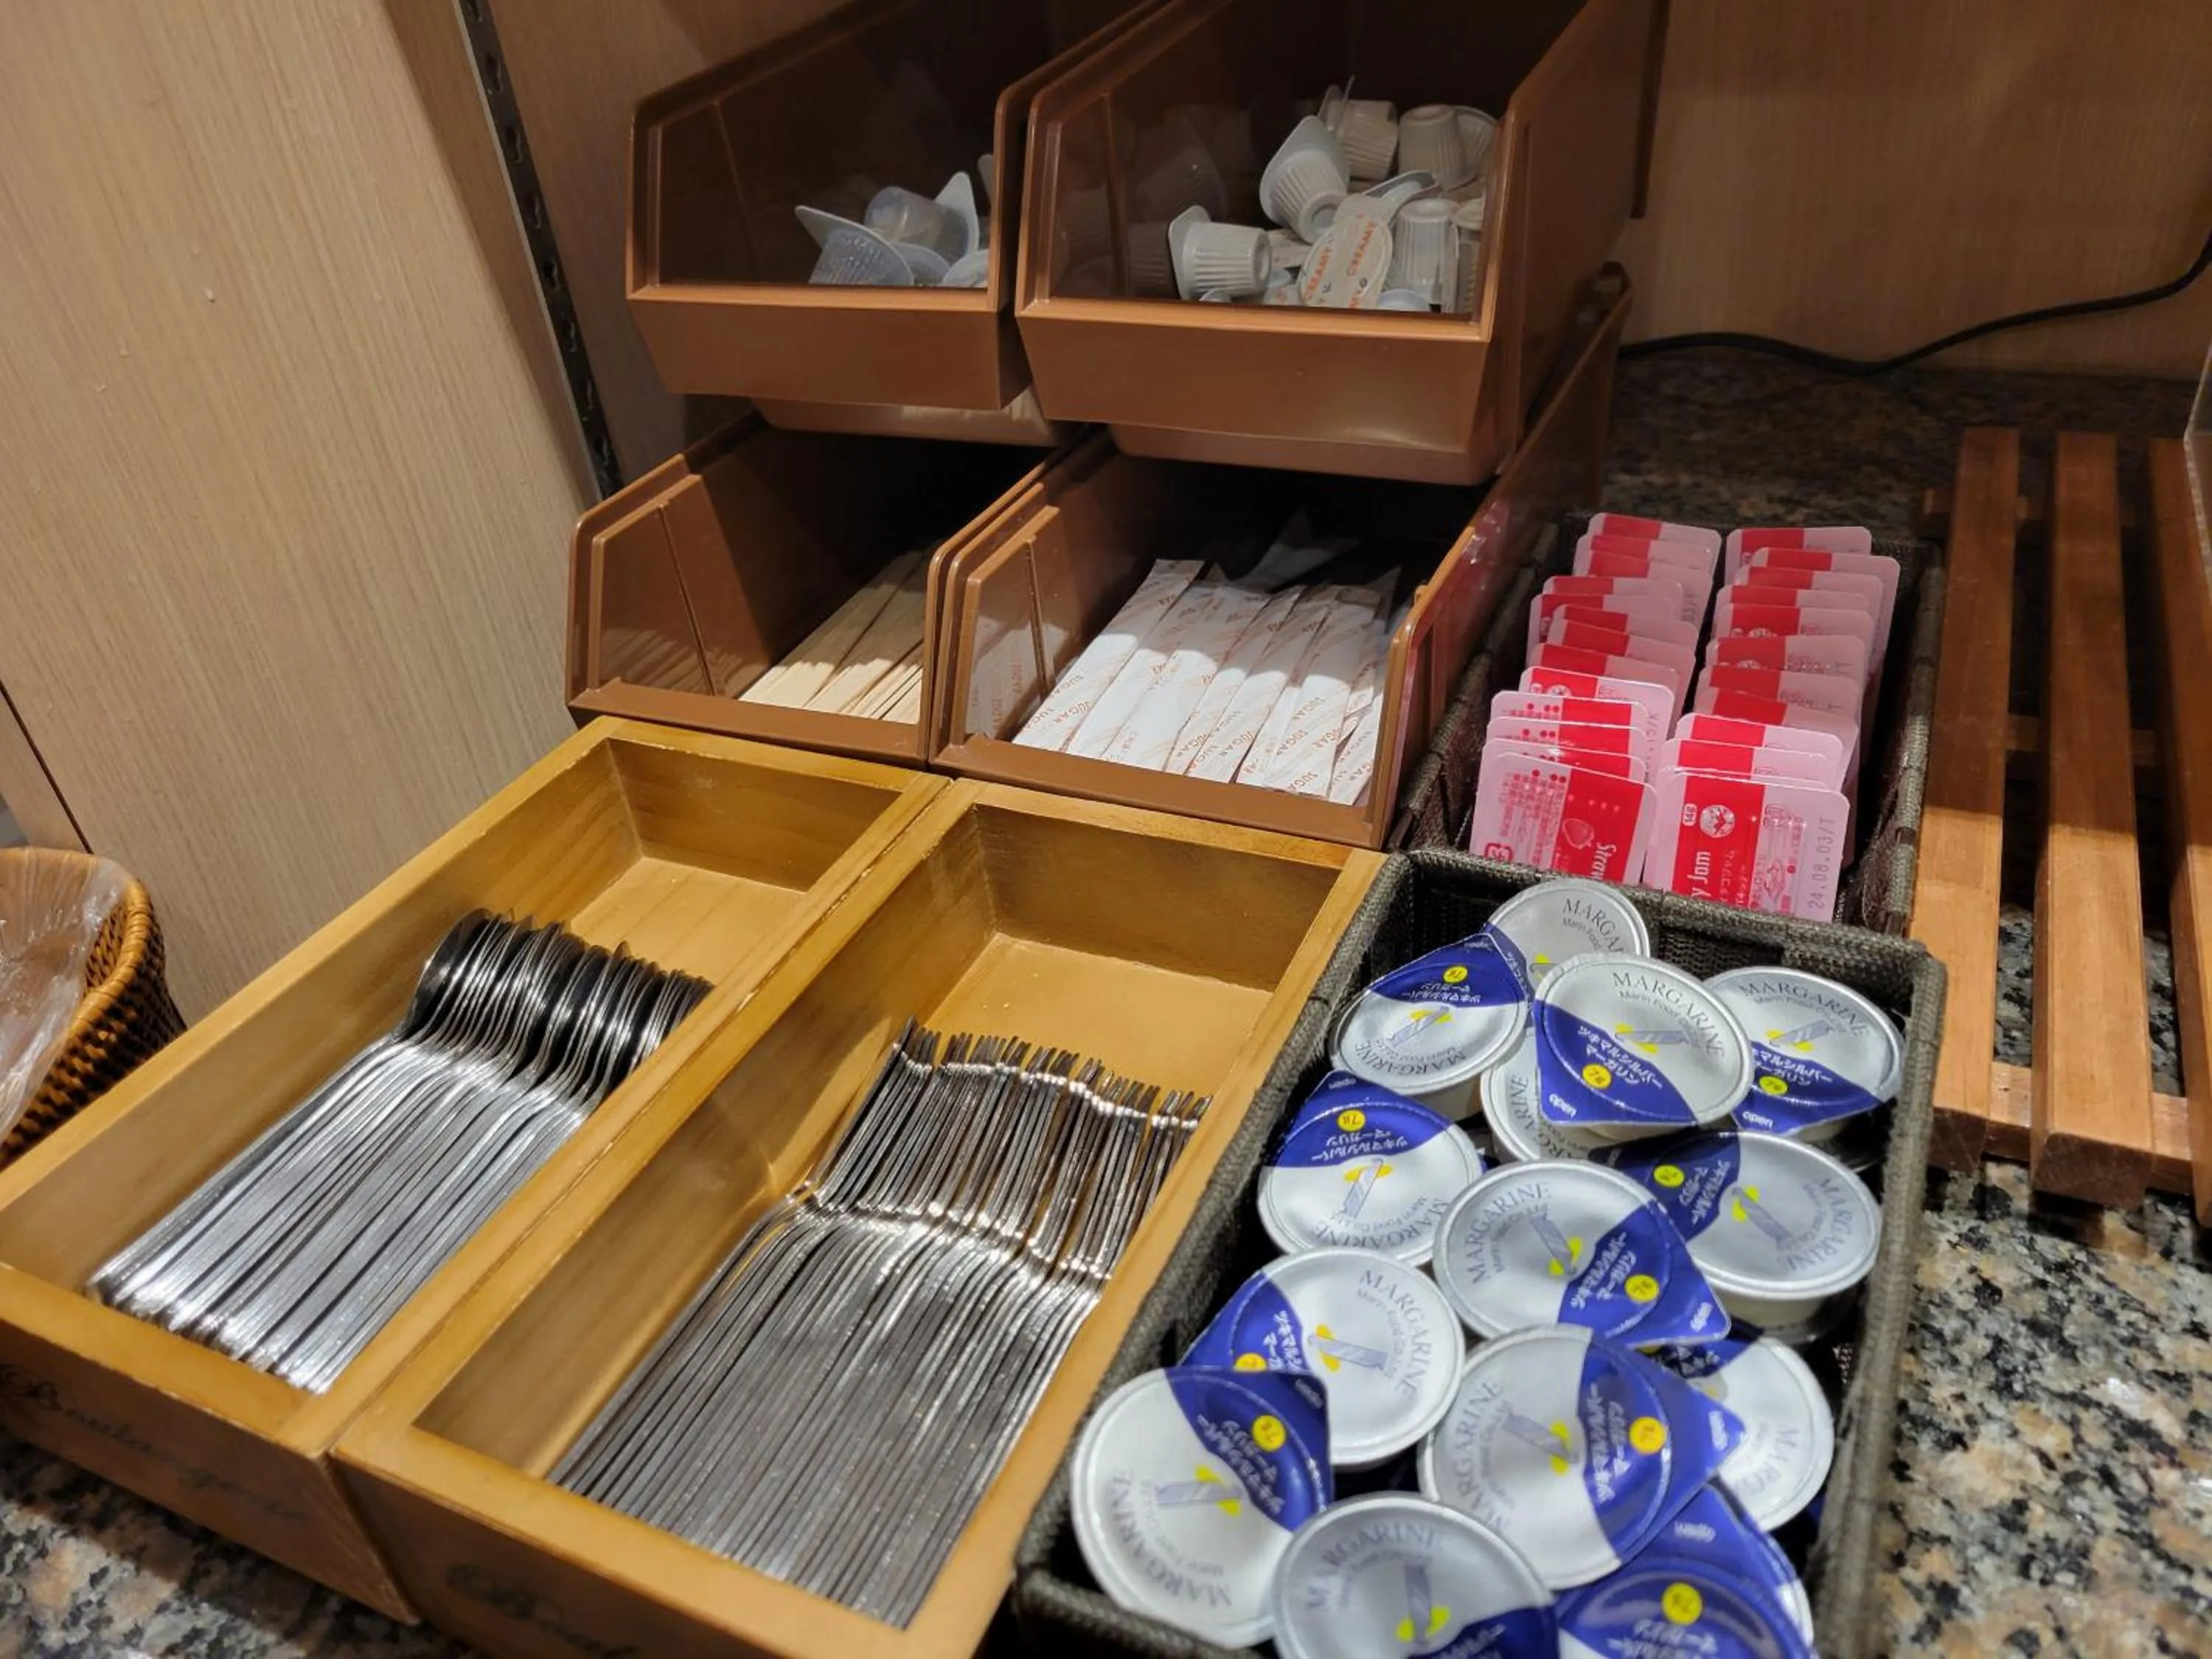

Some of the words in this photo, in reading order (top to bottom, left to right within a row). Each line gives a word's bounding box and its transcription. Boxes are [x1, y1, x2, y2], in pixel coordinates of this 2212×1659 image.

[1687, 852, 1711, 884] Jam
[1809, 815, 1835, 909] 24.08.03/T
[1562, 898, 1624, 952] MARGA
[1613, 972, 1725, 1058] MARGARINE
[1738, 982, 1866, 1036] MARGARINE
[1354, 1040, 1467, 1075] MARGARINE
[1585, 1044, 1640, 1085] マーガリン
[1313, 1197, 1450, 1249] MARGARINE
[1464, 1181, 1551, 1284] MARGARINE
[1359, 1269, 1432, 1401] MARGARINE
[1110, 1467, 1233, 1607] MARGARINE
